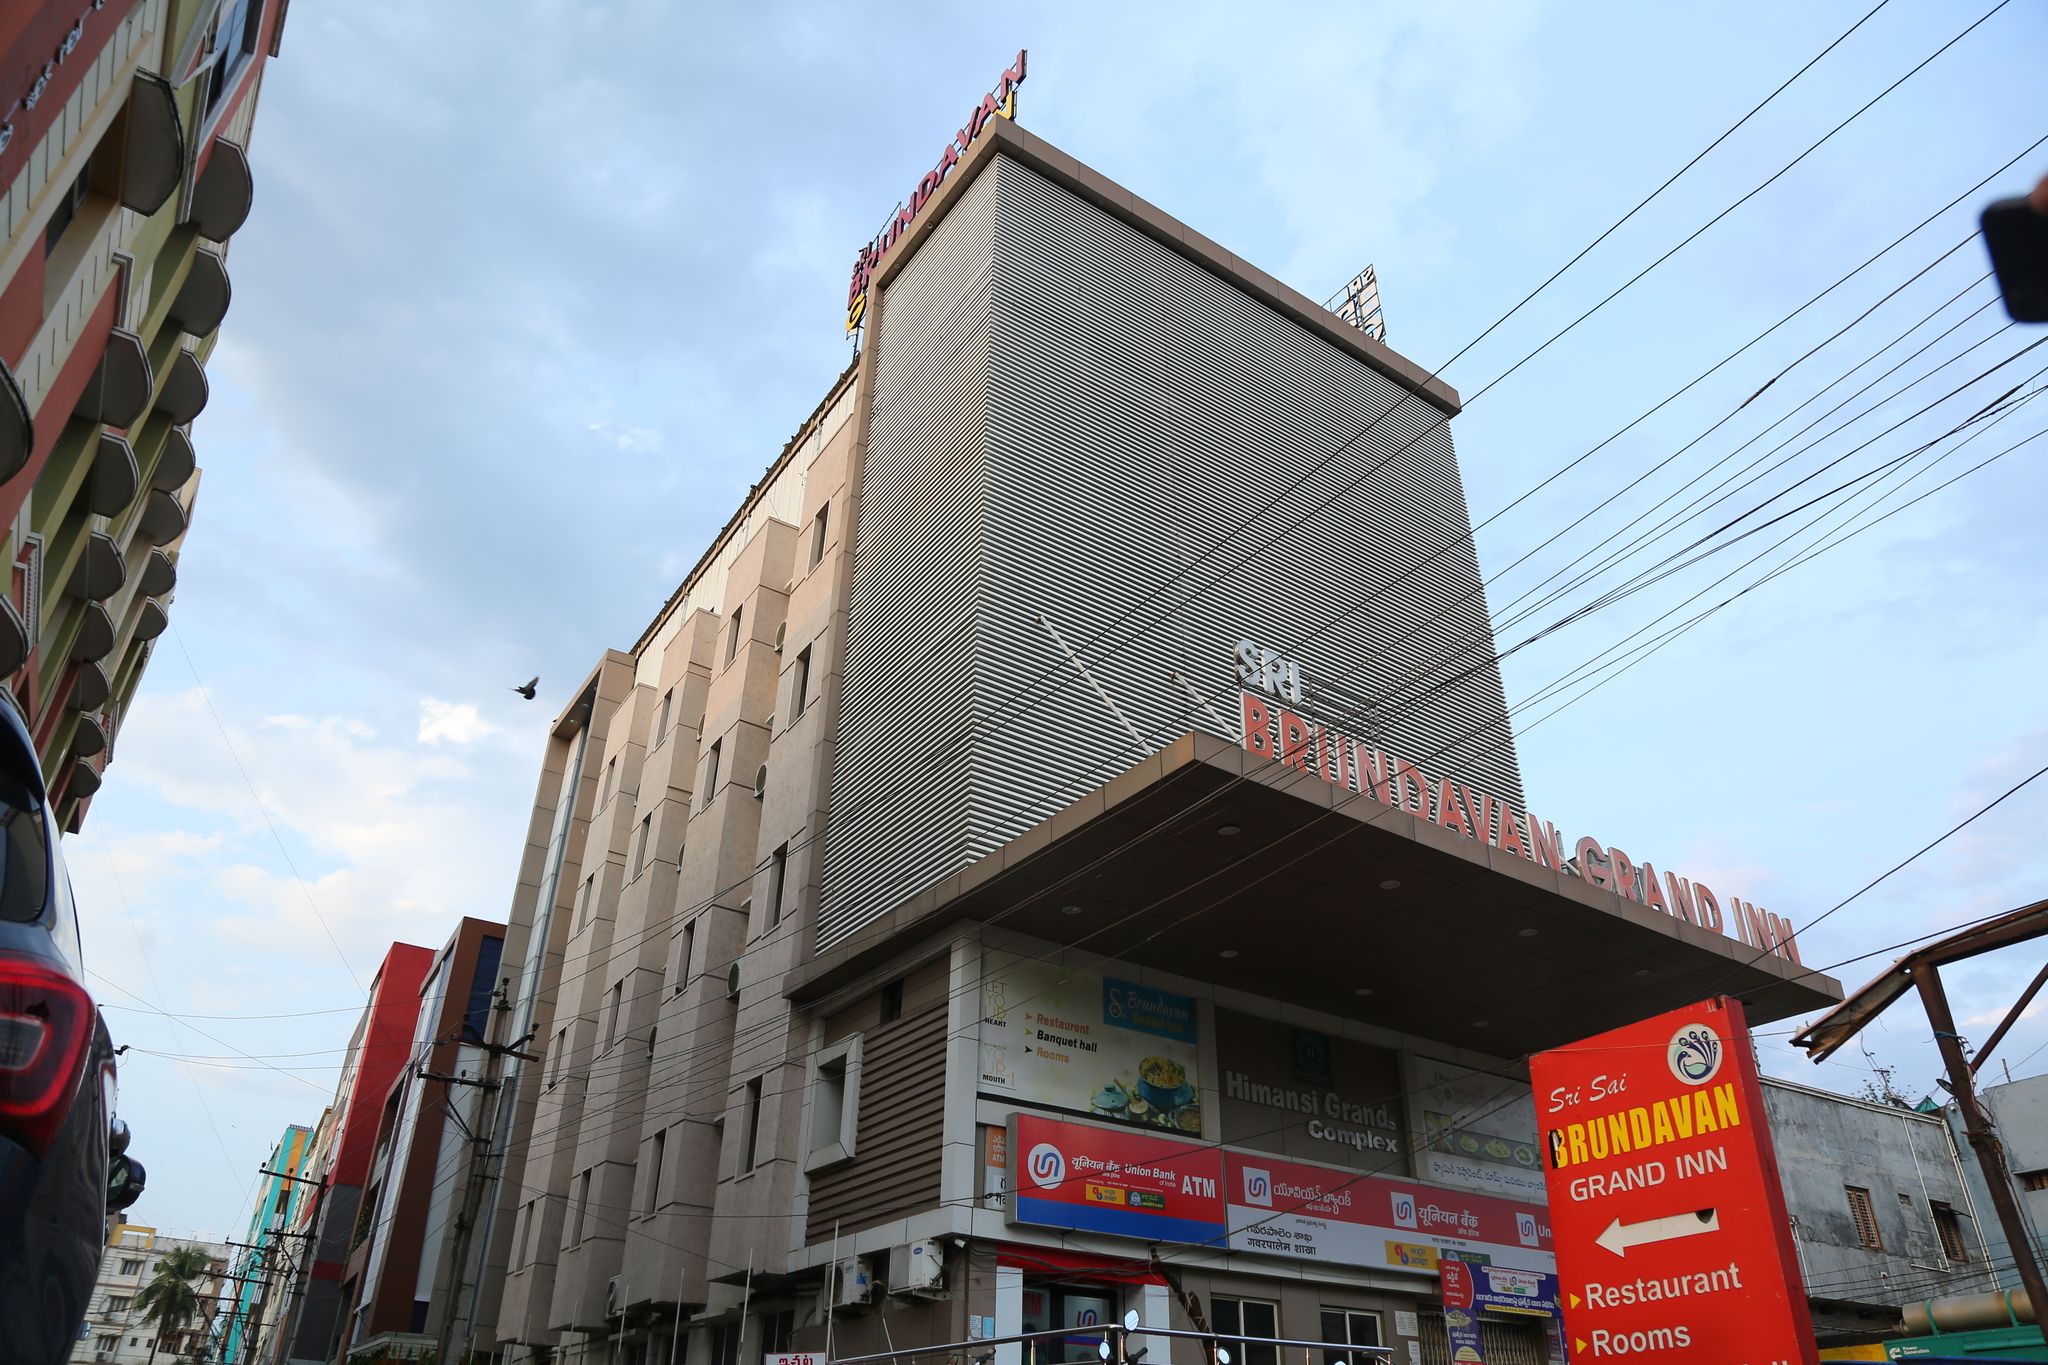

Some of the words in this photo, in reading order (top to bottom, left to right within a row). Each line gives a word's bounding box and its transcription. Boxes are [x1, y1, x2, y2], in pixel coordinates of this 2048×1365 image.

[1234, 639, 1303, 703] SRI
[1240, 690, 1561, 874] BRUNDAVAN
[1574, 835, 1724, 935] GRAND
[1729, 896, 1802, 966] INN
[984, 1017, 1007, 1028] HEART
[1037, 1029, 1077, 1048] Banquet
[1079, 1039, 1097, 1053] hall
[1036, 1046, 1070, 1063] Rooms
[982, 1074, 1006, 1084] MOUTH
[1225, 1070, 1320, 1115] Himansi
[1547, 1086, 1581, 1114] Sri
[1589, 1072, 1628, 1103] Sai
[1307, 1119, 1398, 1153] Complex
[1548, 1082, 1741, 1169] BRUNDAVAN
[1071, 1155, 1105, 1171] यूनियन
[1105, 1160, 1121, 1173] बैंक
[1124, 1163, 1152, 1177] Union
[1152, 1167, 1176, 1181] Bank
[1569, 1160, 1666, 1202] GRAND
[1675, 1145, 1728, 1180] INN
[1181, 1174, 1217, 1199] ATM
[1418, 1204, 1459, 1227] यूनियन
[1461, 1210, 1479, 1229] बैंक
[1538, 1224, 1552, 1238] Un
[1294, 1244, 1317, 1255] शाखा
[1585, 1261, 1743, 1310] Restaurant
[1592, 1325, 1692, 1357] Rooms
